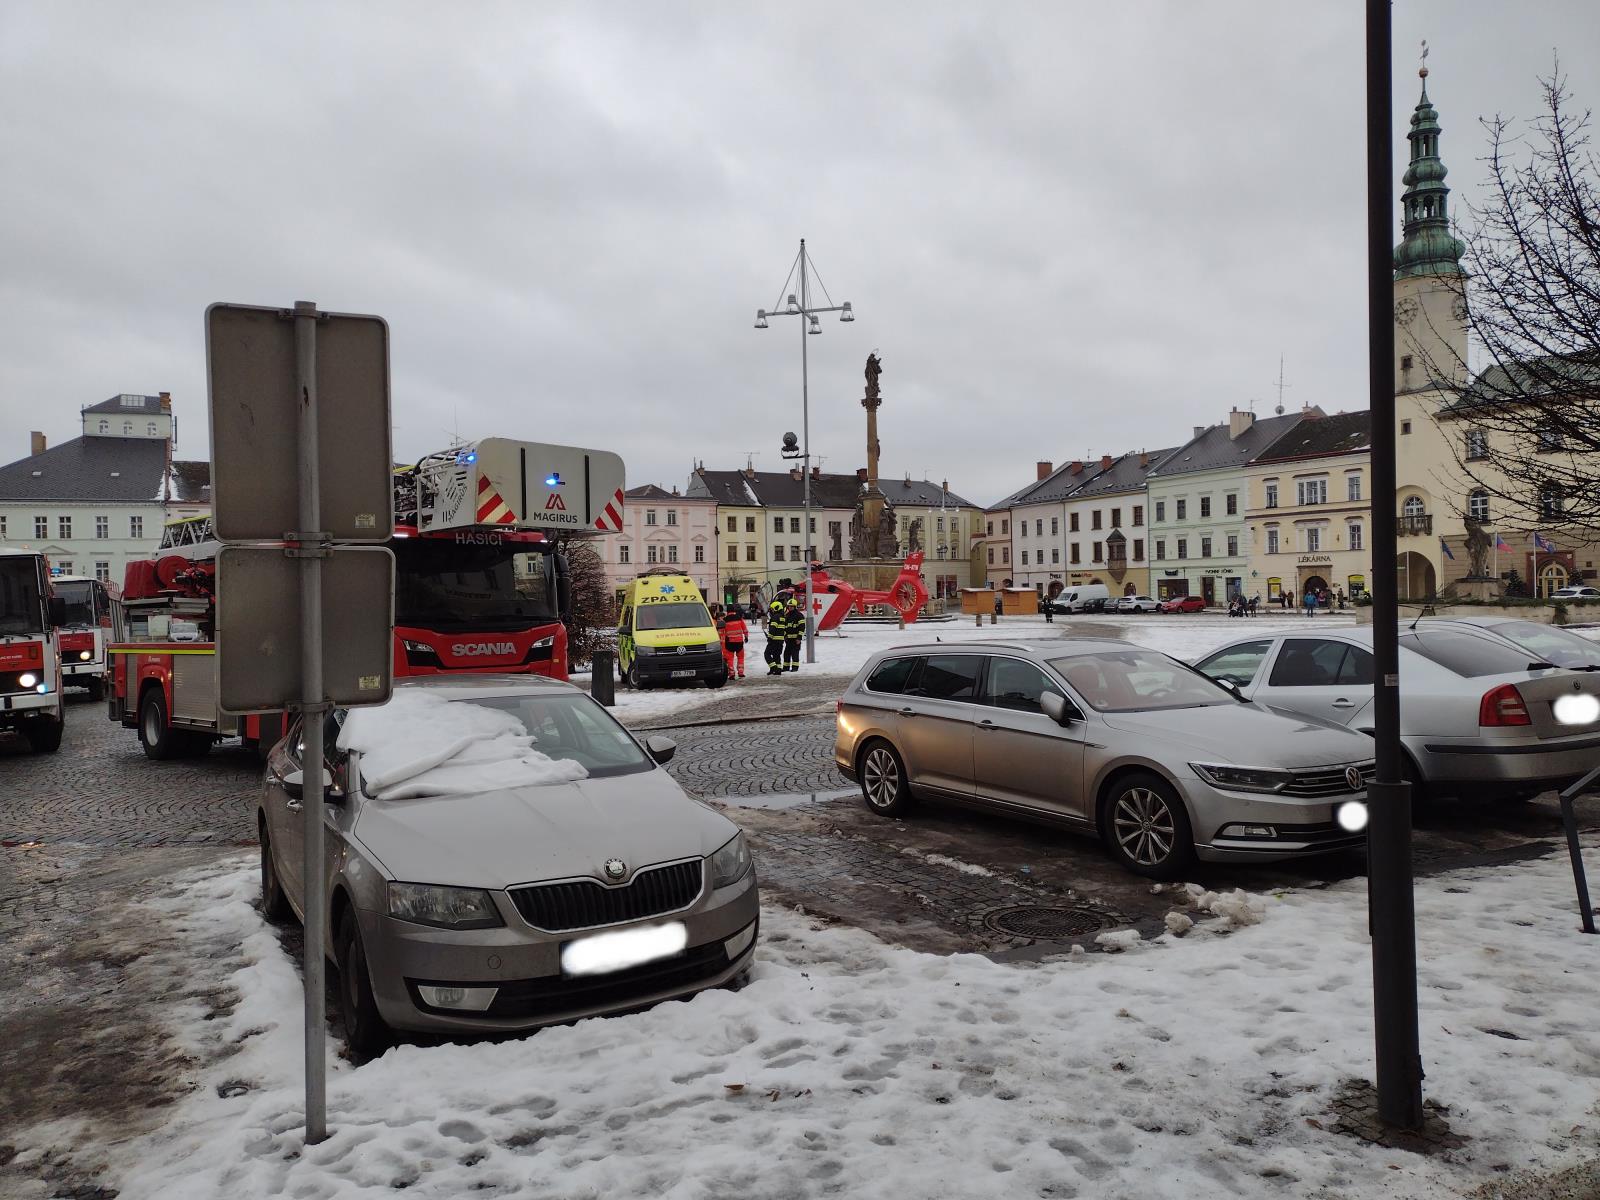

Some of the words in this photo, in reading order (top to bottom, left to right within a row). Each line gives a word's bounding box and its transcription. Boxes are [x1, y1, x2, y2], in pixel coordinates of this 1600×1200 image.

[533, 511, 578, 524] MAGIRUS
[1298, 554, 1331, 563] LÉKÁRNA
[641, 595, 668, 604] ZPA
[672, 594, 698, 602] 372
[451, 642, 517, 657] SCANIA
